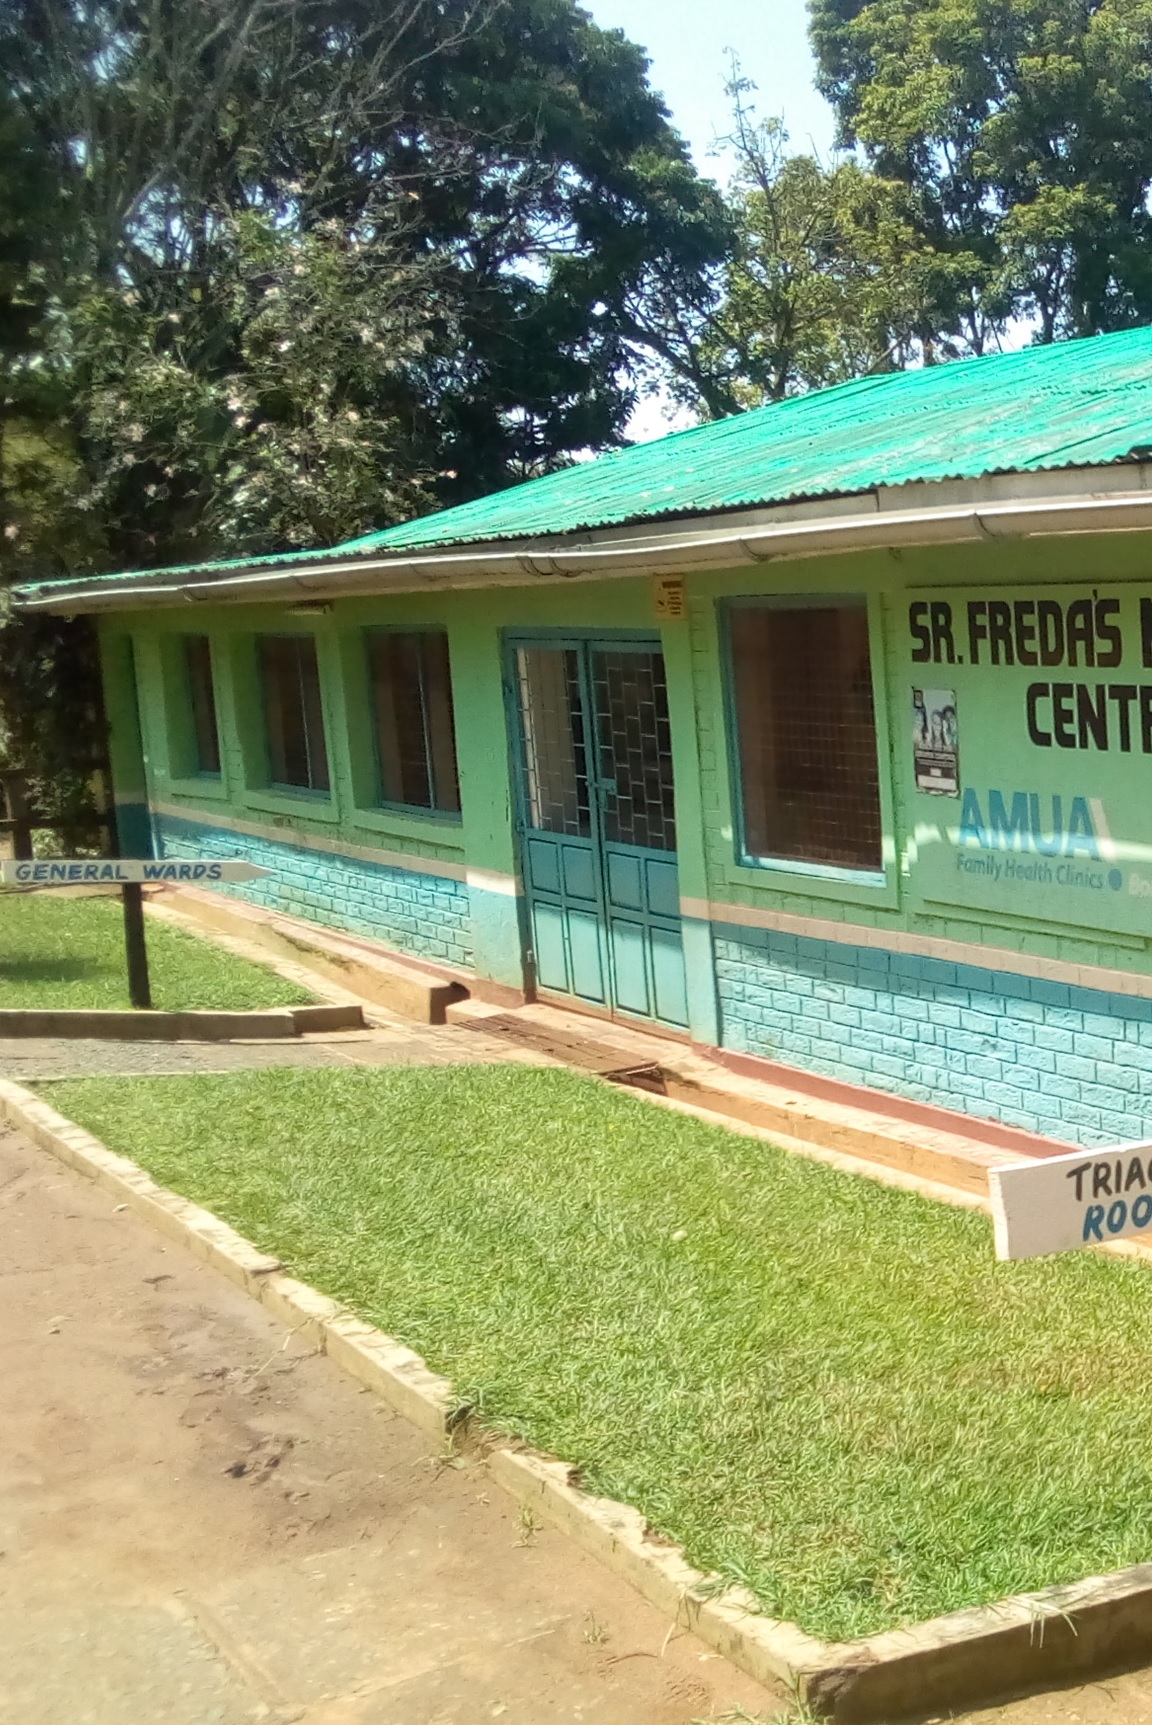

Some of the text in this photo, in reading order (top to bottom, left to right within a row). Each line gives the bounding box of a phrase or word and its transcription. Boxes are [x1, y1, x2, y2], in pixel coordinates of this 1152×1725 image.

[959, 787, 1105, 862] AMUA
[15, 864, 222, 881] GENERAL WARDS
[956, 852, 1001, 882] Family
[1004, 859, 1051, 882] Health
[1056, 866, 1104, 889] Clinics
